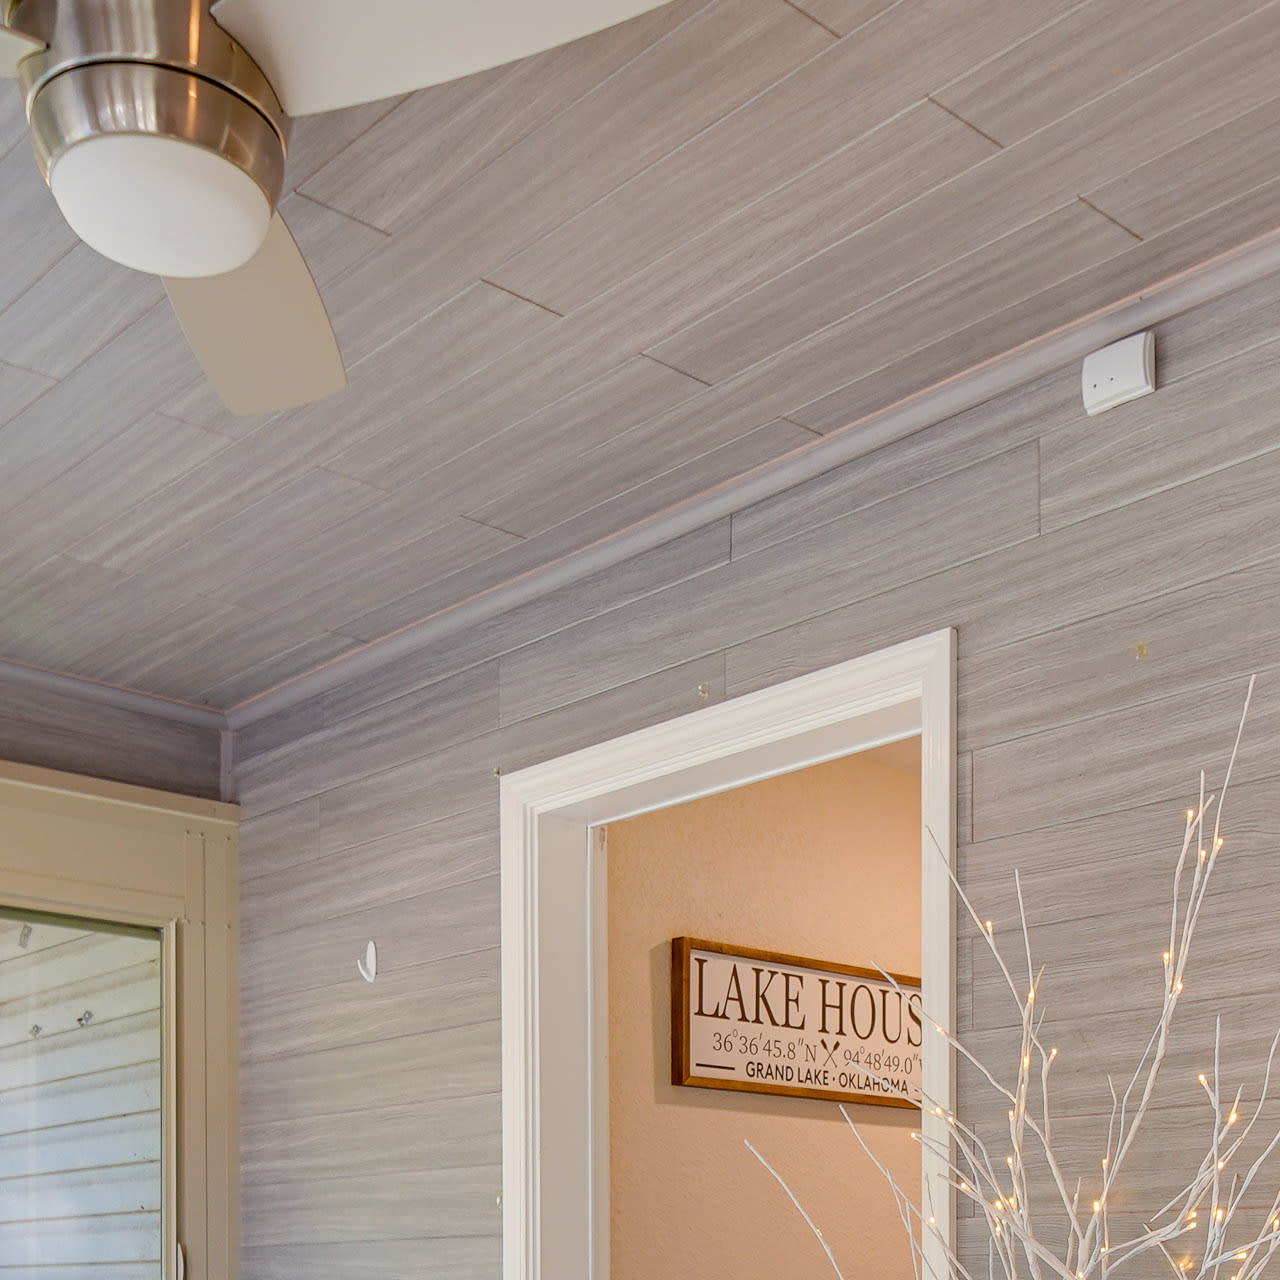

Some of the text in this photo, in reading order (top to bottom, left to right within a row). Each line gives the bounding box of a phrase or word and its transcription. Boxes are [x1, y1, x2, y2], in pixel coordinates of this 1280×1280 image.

[694, 957, 806, 1030] LAKE
[746, 1061, 908, 1095] GRAND LAKE OKLAHOMA
